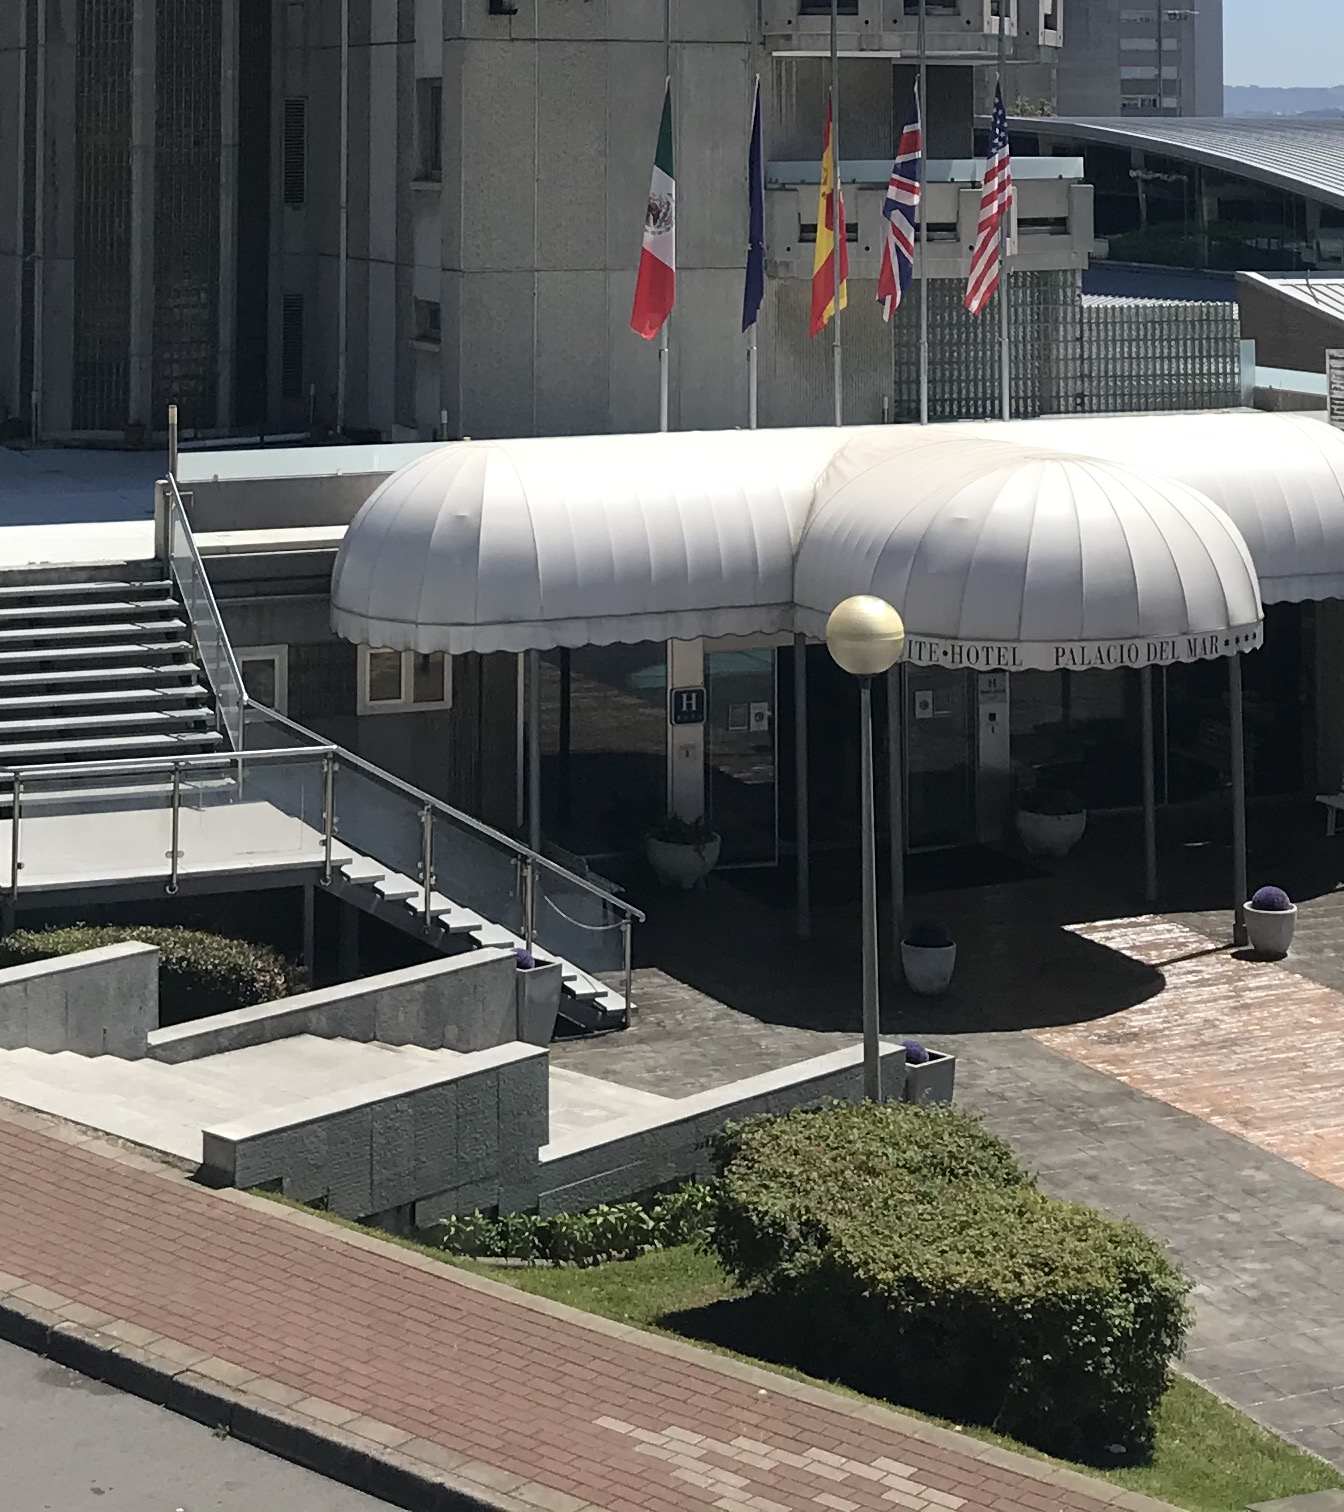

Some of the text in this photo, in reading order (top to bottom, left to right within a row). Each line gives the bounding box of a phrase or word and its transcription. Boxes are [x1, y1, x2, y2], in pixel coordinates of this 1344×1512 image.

[1054, 643, 1140, 666] PALACIO
[1146, 640, 1180, 662] DEL
[1186, 635, 1219, 658] MAR
[680, 692, 698, 712] H
